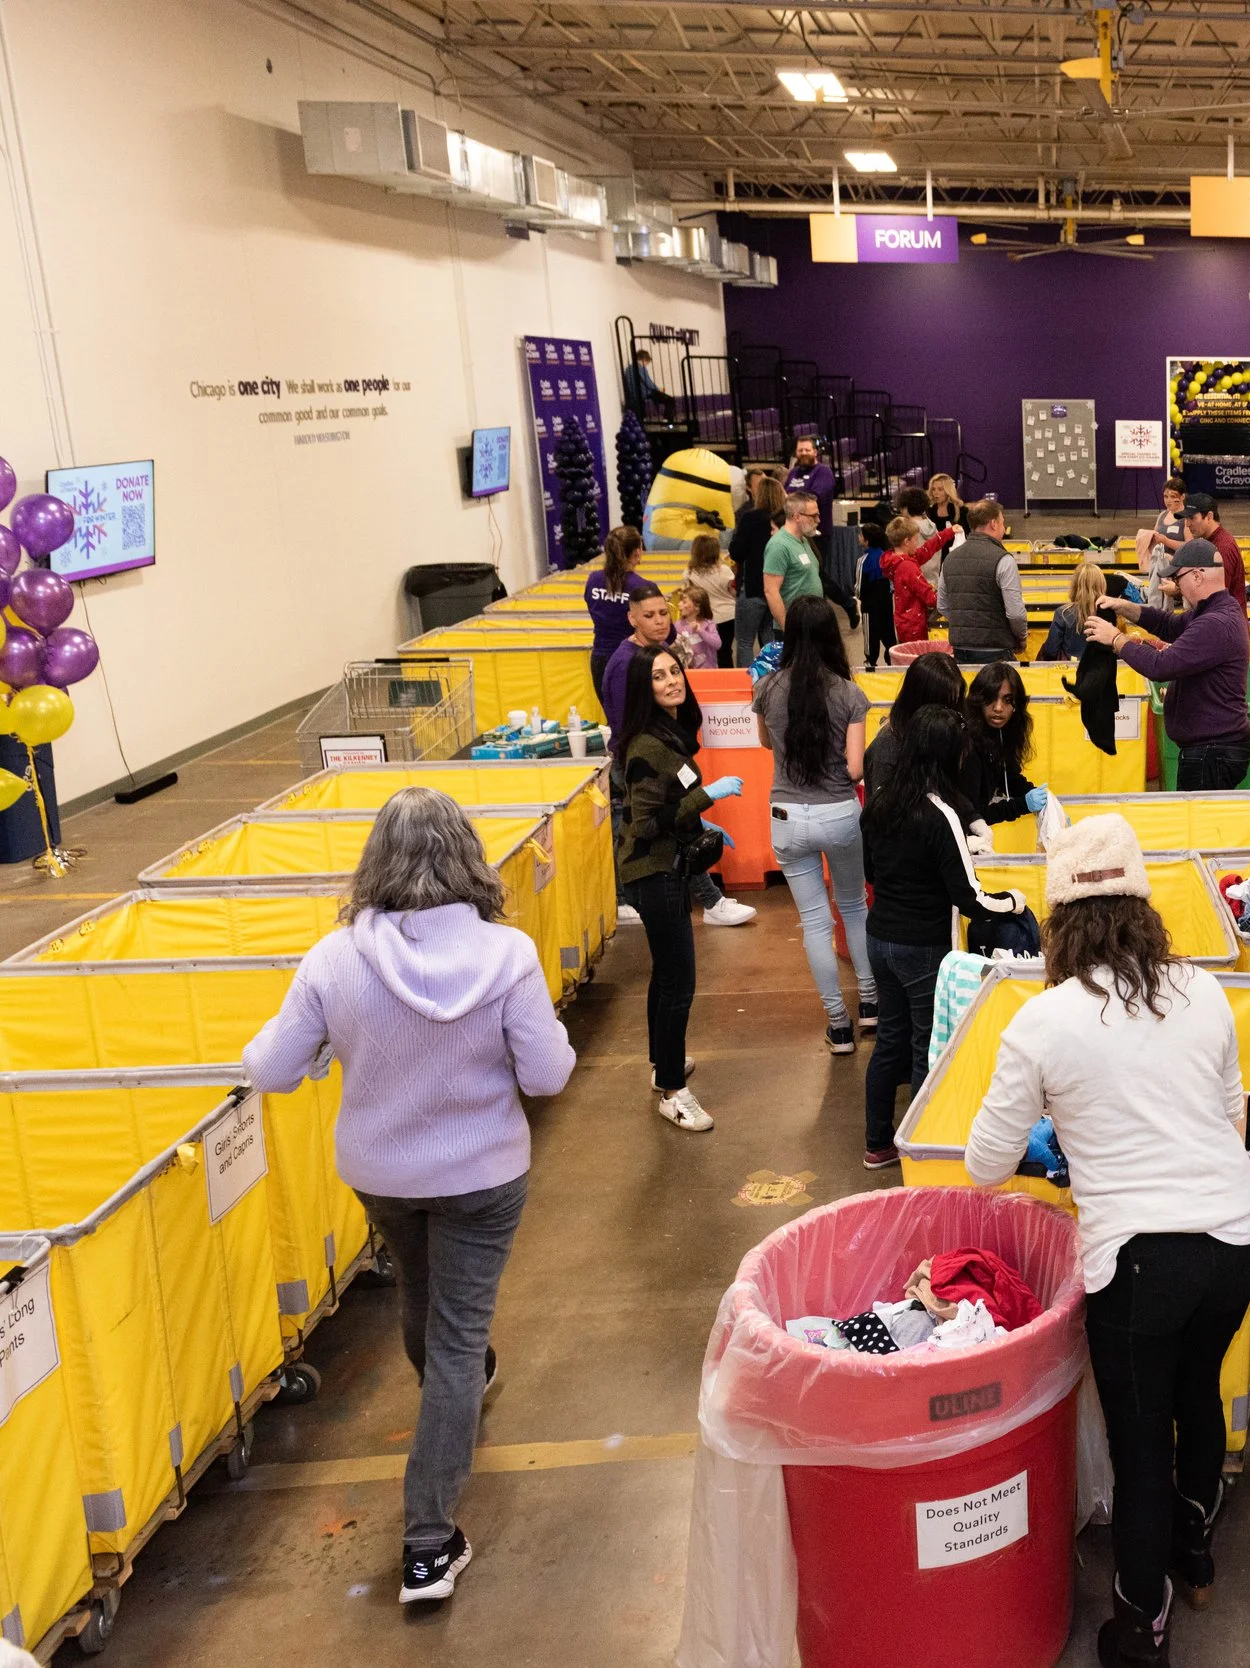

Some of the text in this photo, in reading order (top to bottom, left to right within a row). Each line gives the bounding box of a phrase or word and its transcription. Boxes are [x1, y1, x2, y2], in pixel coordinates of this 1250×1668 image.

[875, 229, 942, 250] FORUM
[190, 380, 226, 400] Chicago
[228, 379, 236, 396] is
[238, 380, 259, 396] one
[261, 376, 281, 399] city
[286, 379, 299, 394] We
[300, 378, 316, 394] shall
[316, 380, 335, 393] work
[336, 383, 343, 393] as
[343, 379, 360, 392] one
[362, 374, 390, 396] people
[258, 409, 292, 424] common
[295, 406, 314, 425] good
[316, 405, 328, 420] and
[329, 408, 340, 419] our
[342, 407, 369, 418] common
[115, 474, 149, 490] DONATE
[122, 488, 143, 502] NOW
[591, 587, 630, 604] STAFF
[708, 715, 751, 727] Hygiene
[710, 728, 752, 736] NEW ONLY
[233, 1114, 255, 1139] Shorts
[219, 1134, 254, 1175] and Capris
[8, 1297, 35, 1329] Long
[926, 1482, 1022, 1520] Does Not Meet
[953, 1511, 1001, 1533] Quality
[944, 1524, 1009, 1553] Standards
